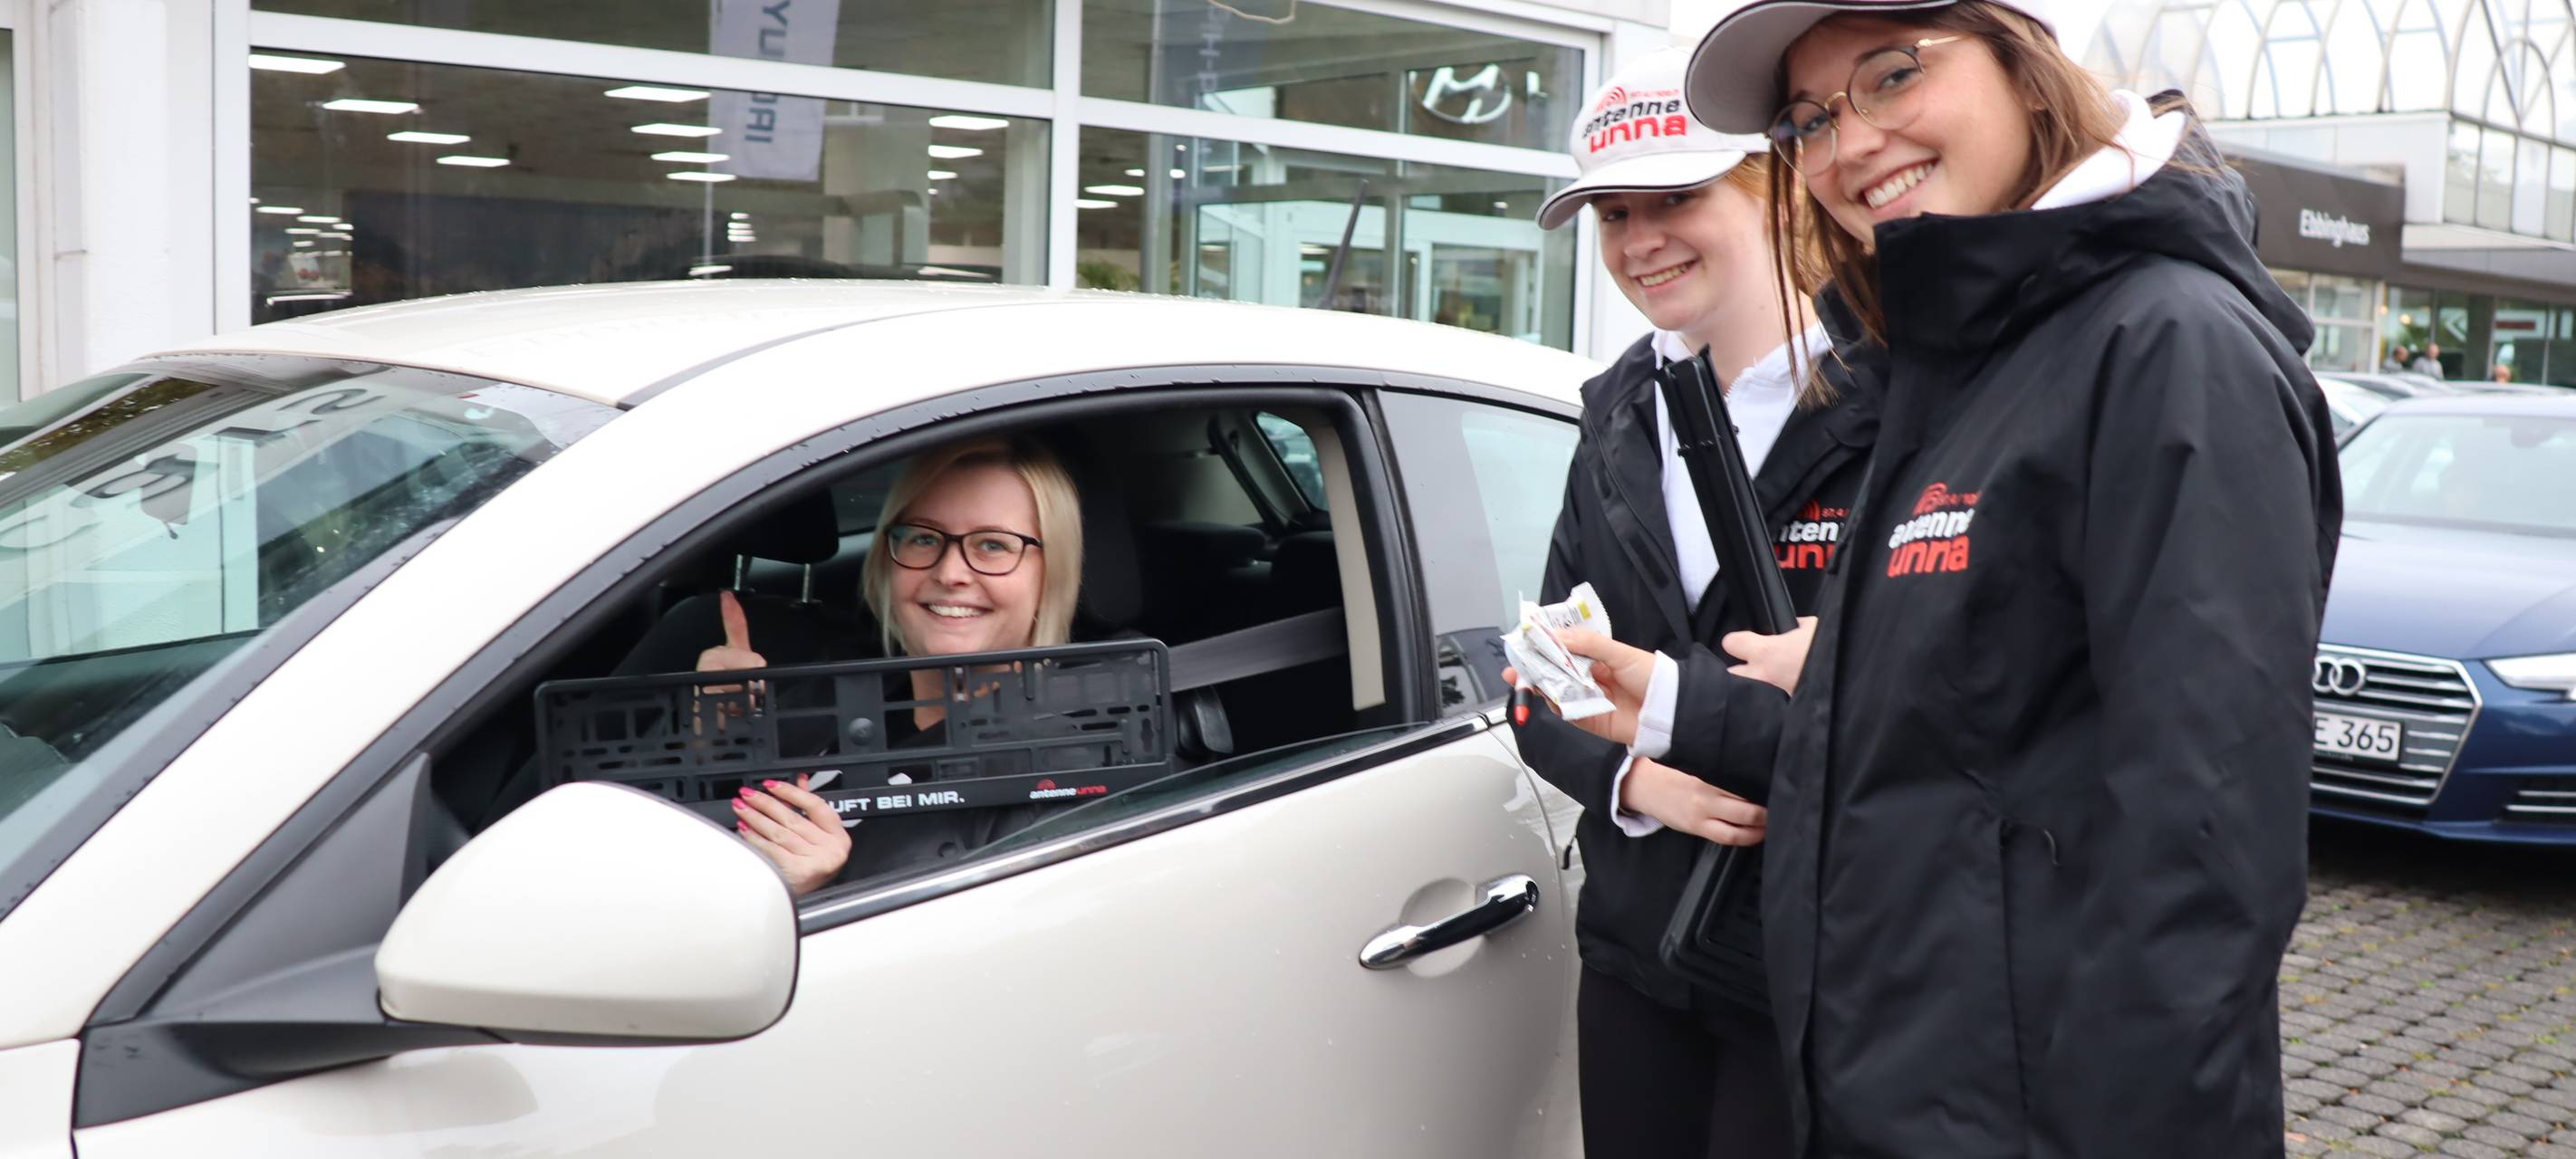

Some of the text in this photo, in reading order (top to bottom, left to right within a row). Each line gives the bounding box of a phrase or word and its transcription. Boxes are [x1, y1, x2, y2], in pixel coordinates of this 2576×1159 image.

[1590, 114, 1687, 153] unna
[2300, 208, 2370, 247] Ebbinghaus
[1887, 535, 1969, 578] unna
[2337, 719, 2396, 752] 365
[877, 795, 912, 809] BEI
[918, 790, 965, 806] MIR.
